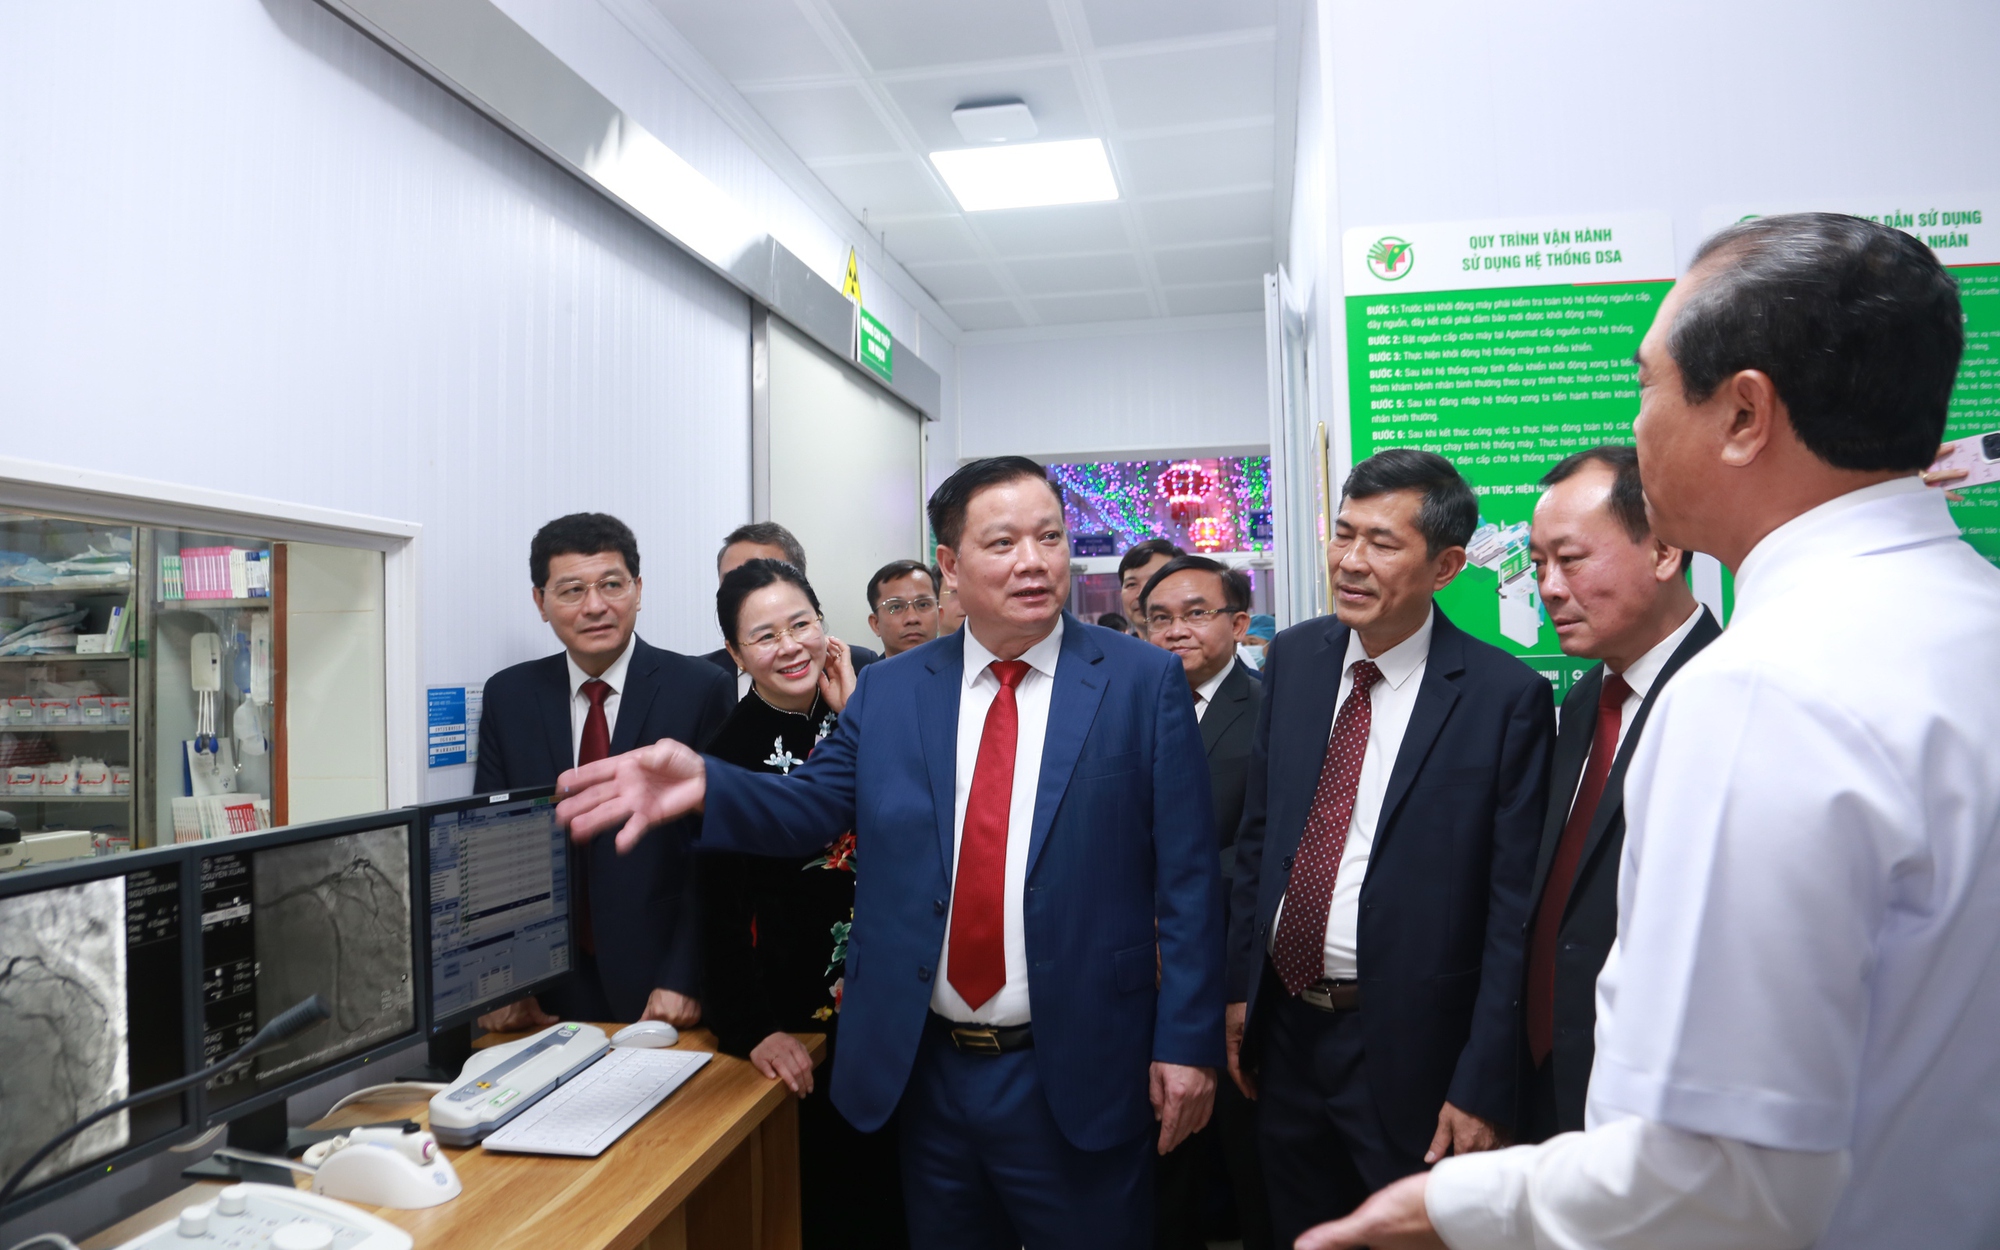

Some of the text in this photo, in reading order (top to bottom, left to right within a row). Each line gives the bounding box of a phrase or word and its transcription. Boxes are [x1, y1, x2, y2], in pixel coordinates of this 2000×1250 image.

[1884, 210, 1913, 228] DẪN
[1918, 208, 1938, 227] SỬ
[1942, 210, 1982, 229] DỤNG
[1470, 226, 1612, 250] QUY TRÌNH VẬN HÀNH
[1928, 231, 1968, 248] NHÂN
[1462, 247, 1622, 272] SỬ DỤNG HỆ THỐNG DSA
[1367, 292, 1634, 316] BƯỚC 1: Trước khi khởi động máy phải kiểm tra toàn bộ hệ thống nguồn
[1411, 309, 1605, 328] dây kết nối phải bảo mới được khởi động máy.
[1368, 323, 1634, 346] BƯỚC 2: Bật nguồn cấp cho máy Aptomat cấp nguồn cho hệ thống.
[1369, 342, 1594, 362] BƯỚC 3: Thực hiện khởi động hệ thống máy tính điều khiển.
[1370, 359, 1618, 379] BƯỚC 4: Sau khi hệ thống máy khởi động xong ta
[1370, 373, 1610, 393] thăm khám bệnh nhân thường theo quy thực hiện cho
[1371, 389, 1636, 410] BƯỚC 5: Sau khi đăng nhập hệ thống xong ta hành thăm khám
[1371, 414, 1390, 424] nhân
[1372, 420, 1630, 440] BƯỚC Sau khi kết thúc công việc ta thực hiện bộ các
[1444, 437, 1576, 452] chạy trên hệ thống Thực hiện
[1476, 452, 1545, 465] cấp cho hệ thống
[1491, 484, 1514, 496] THỰC
[1515, 482, 1534, 496] HIỆN
